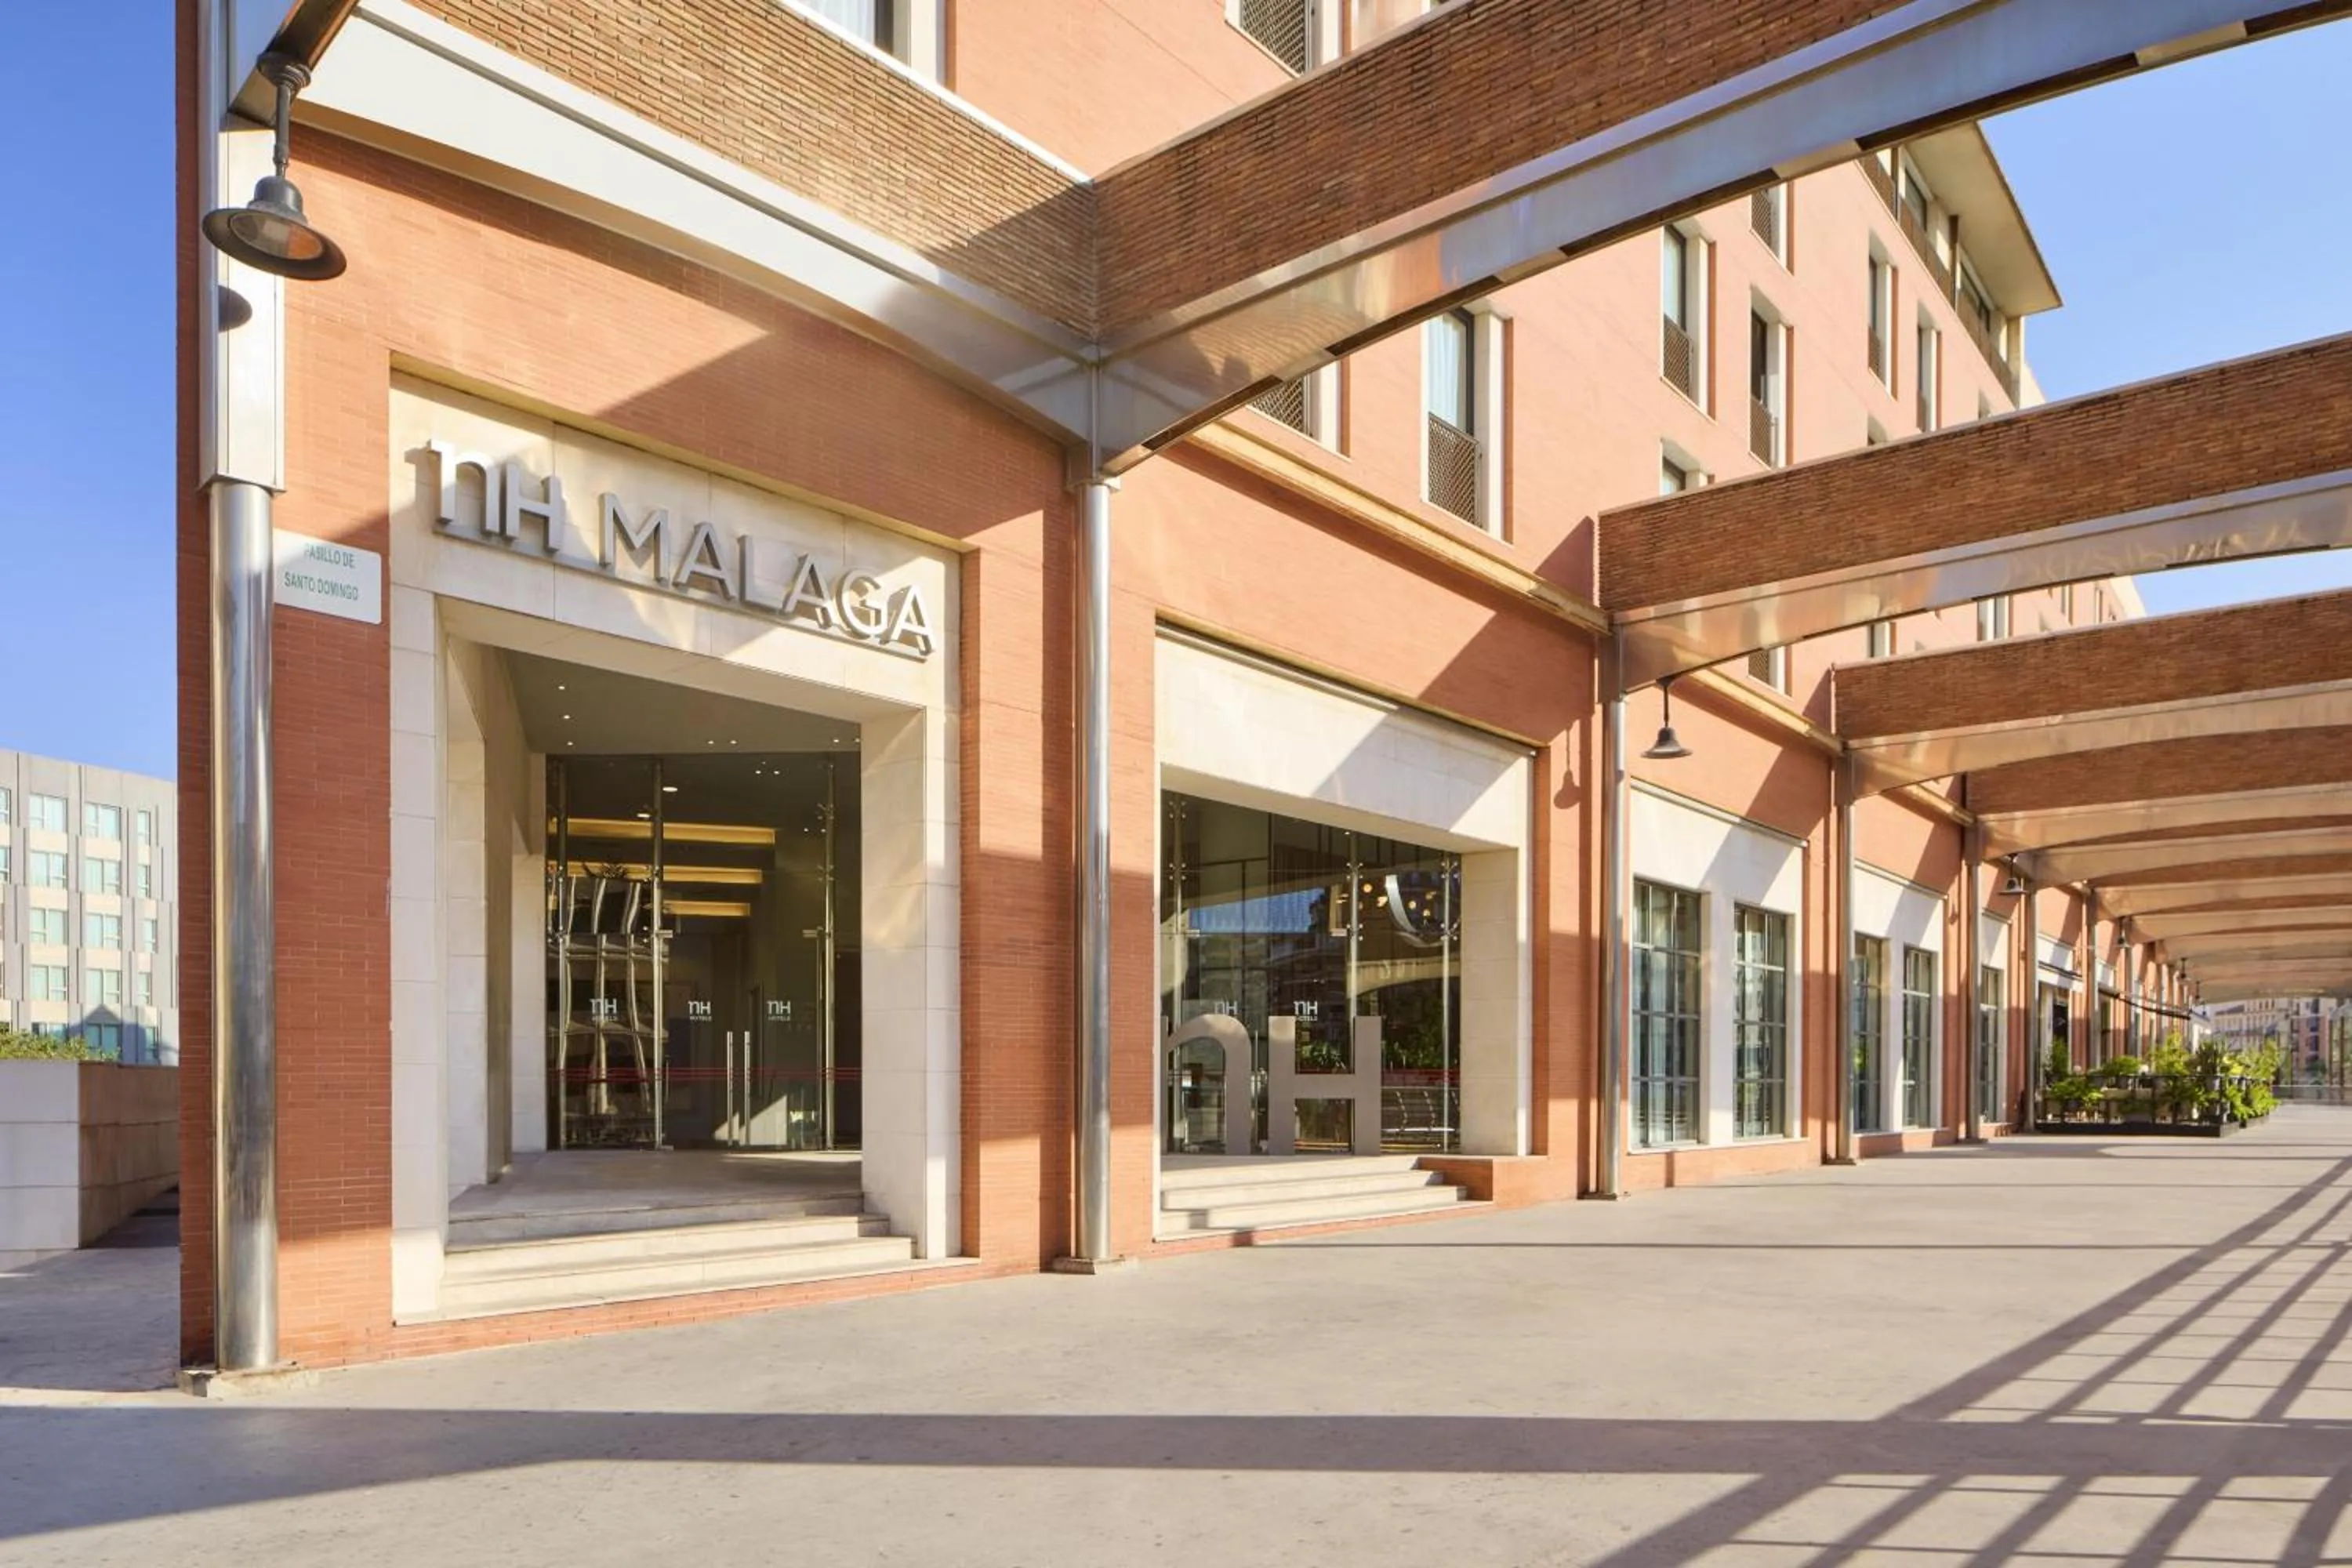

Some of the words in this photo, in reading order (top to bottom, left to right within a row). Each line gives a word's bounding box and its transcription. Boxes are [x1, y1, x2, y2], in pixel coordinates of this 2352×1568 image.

[343, 551, 355, 568] DE
[598, 492, 935, 655] MALAGA
[284, 572, 315, 591] SANTO
[317, 577, 358, 601] DOMINGO
